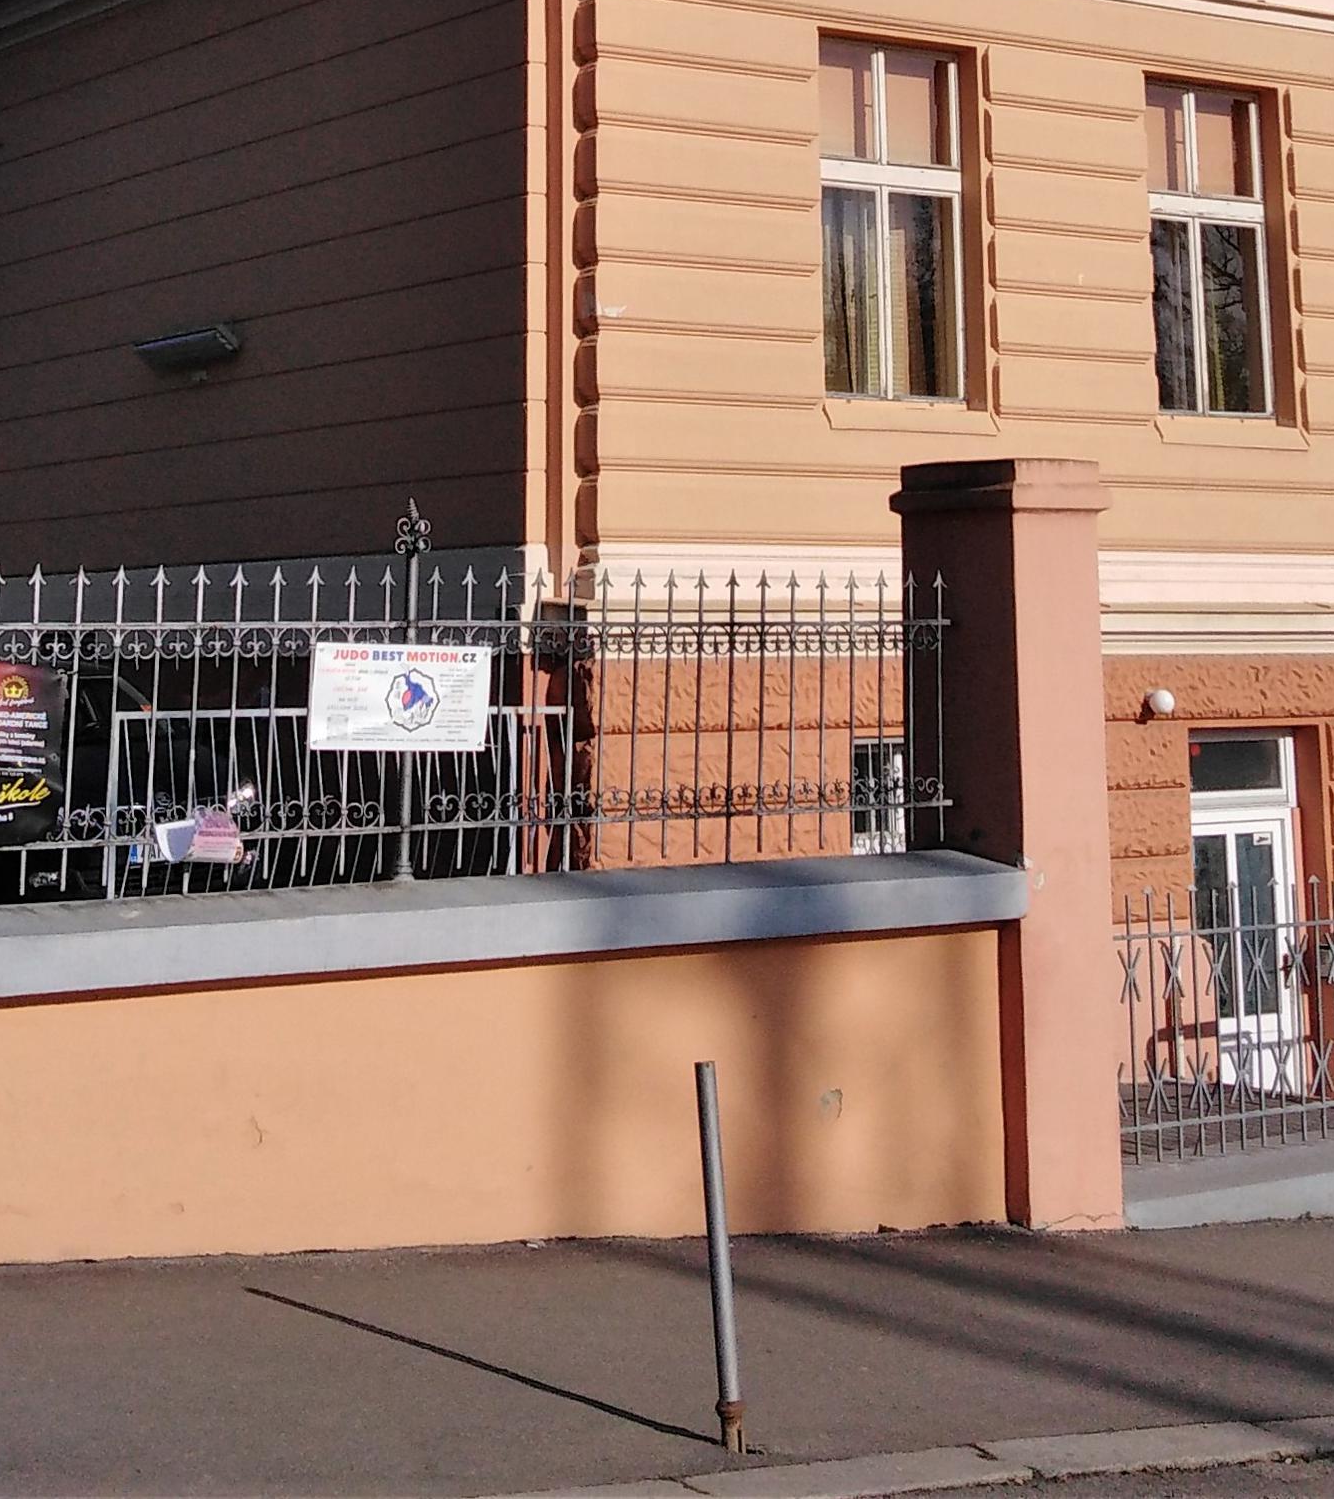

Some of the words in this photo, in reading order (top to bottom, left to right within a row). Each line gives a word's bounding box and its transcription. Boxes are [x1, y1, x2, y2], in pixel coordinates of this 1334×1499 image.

[333, 649, 369, 661] JUDO
[372, 650, 404, 662] BEST
[406, 651, 477, 663] MOTION.CZ
[0, 778, 51, 804] škole
